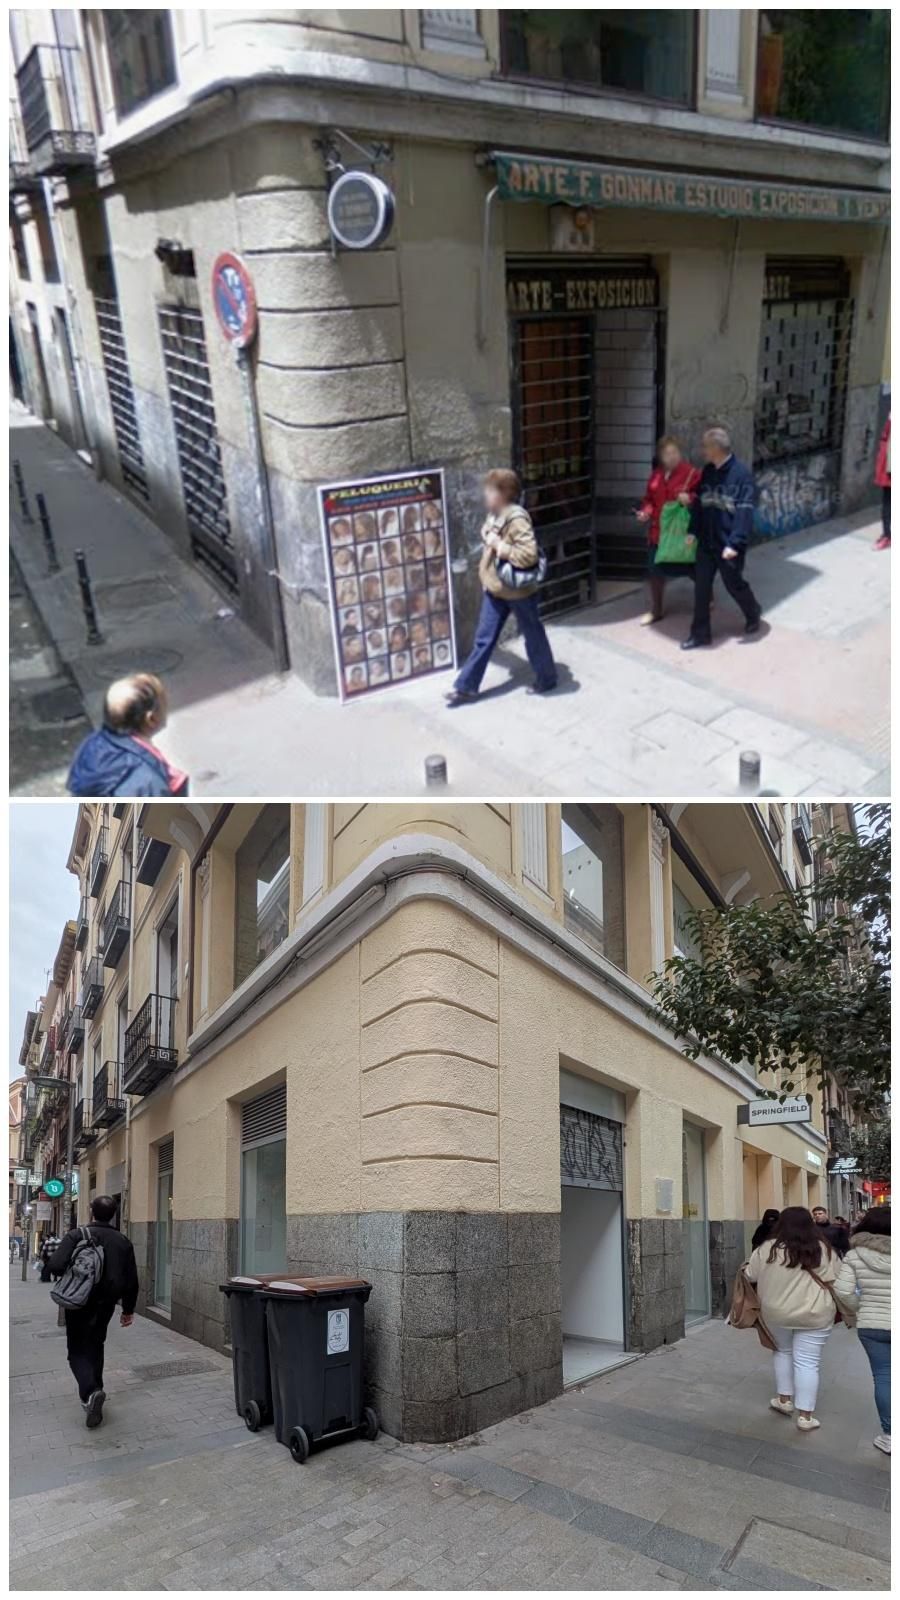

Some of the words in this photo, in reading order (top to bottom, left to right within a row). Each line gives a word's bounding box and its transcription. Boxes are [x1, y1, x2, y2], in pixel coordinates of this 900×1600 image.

[602, 173, 676, 205] GONMAR
[684, 183, 754, 211] ESTUDIO
[751, 1104, 808, 1117] SPRINGFIELD
